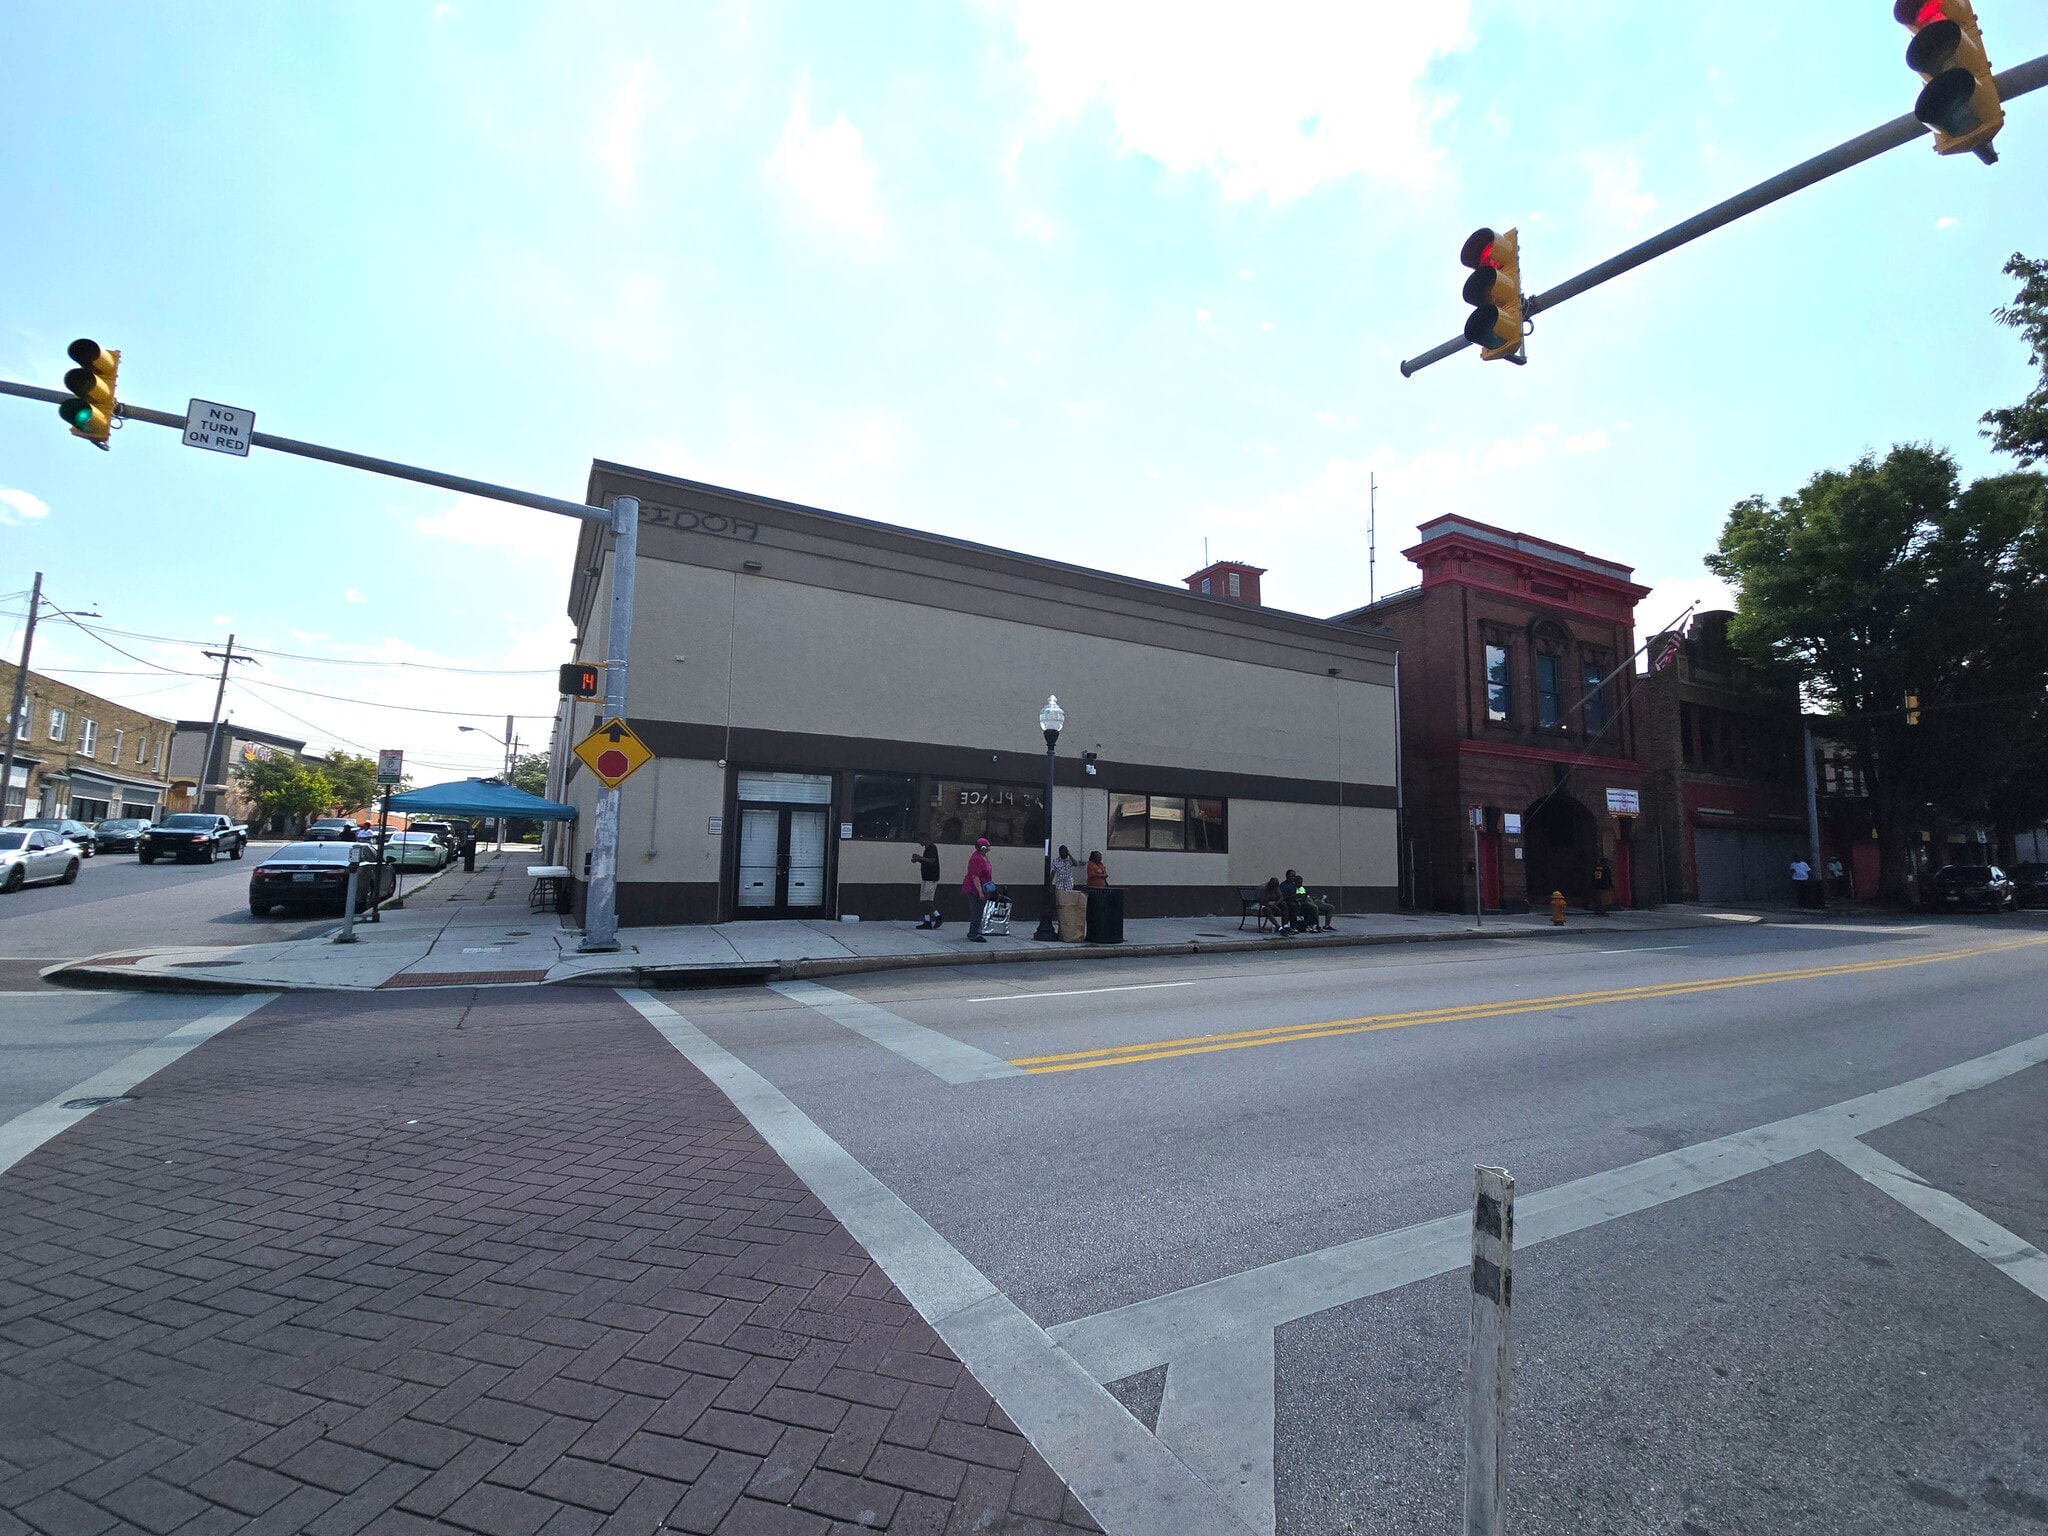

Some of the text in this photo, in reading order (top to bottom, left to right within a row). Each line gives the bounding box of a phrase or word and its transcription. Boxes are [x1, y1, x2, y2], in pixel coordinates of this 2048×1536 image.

[209, 408, 234, 422] NO
[200, 419, 239, 436] TURN
[189, 431, 244, 450] ON RED
[582, 673, 594, 690] 14
